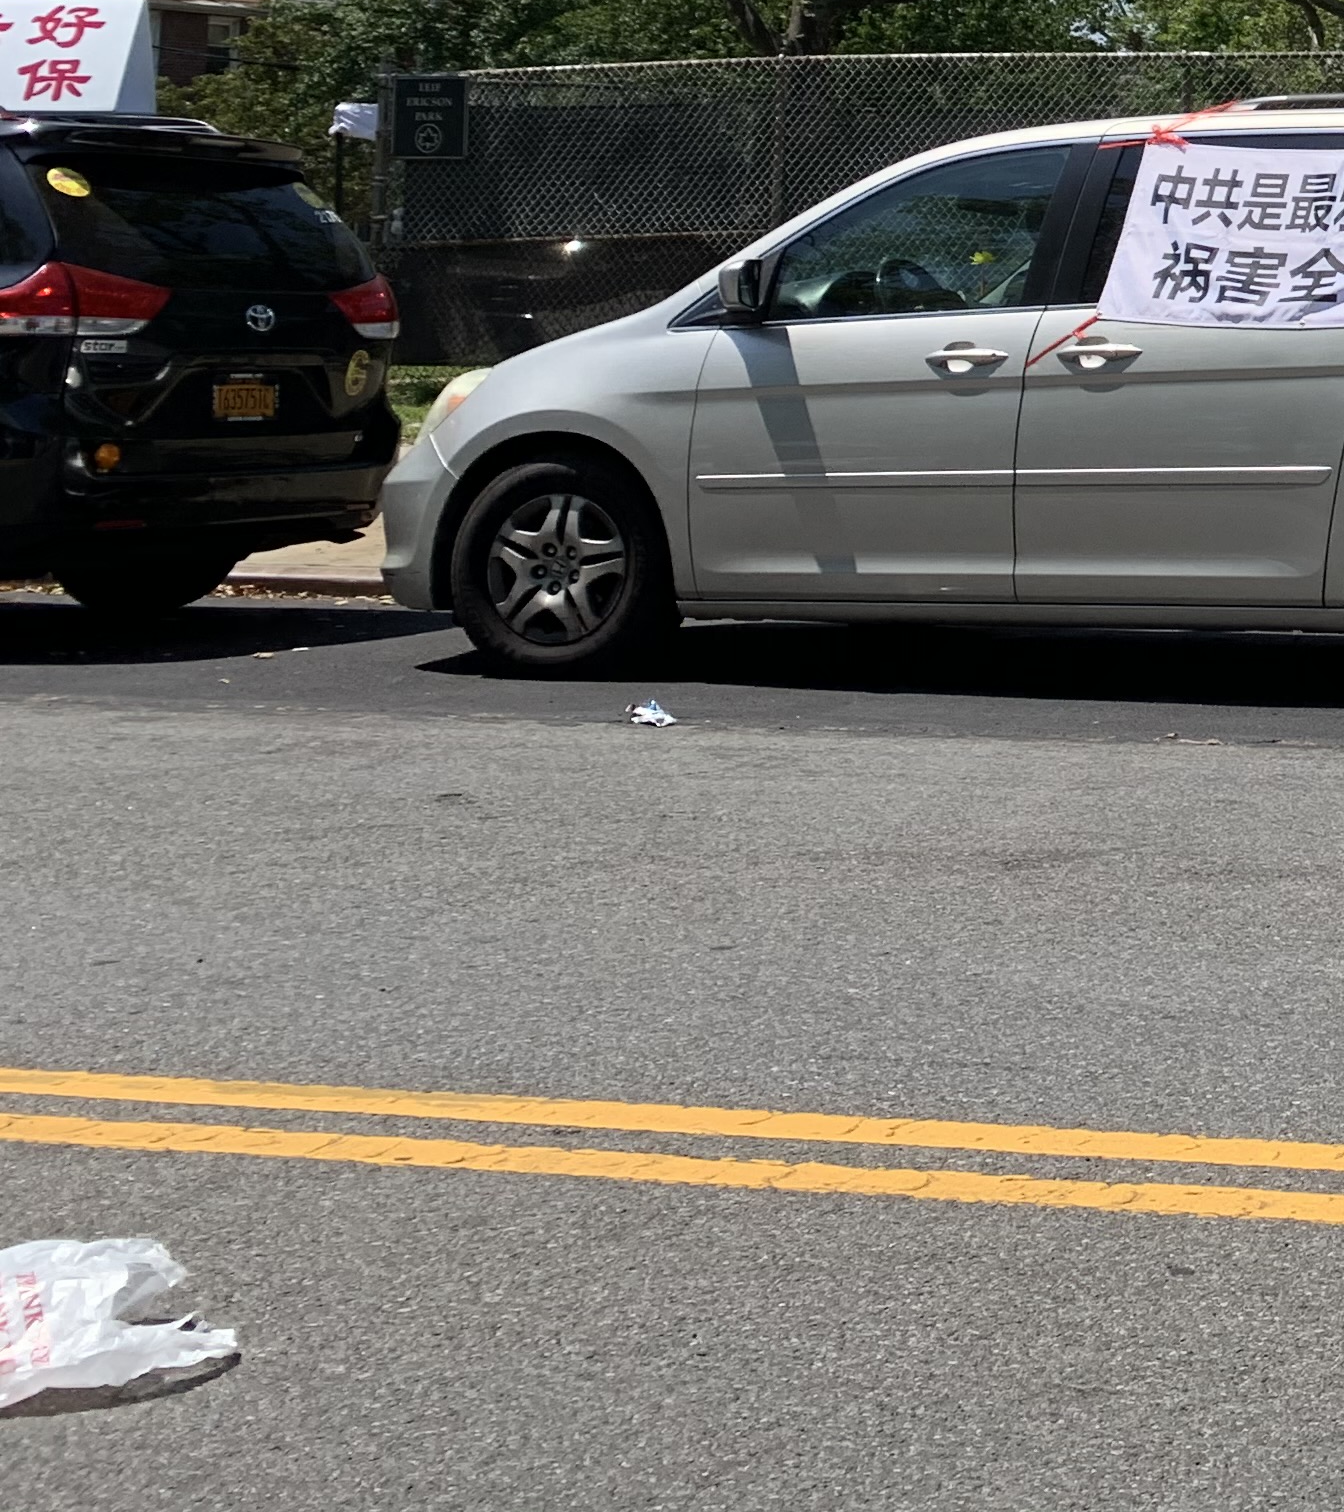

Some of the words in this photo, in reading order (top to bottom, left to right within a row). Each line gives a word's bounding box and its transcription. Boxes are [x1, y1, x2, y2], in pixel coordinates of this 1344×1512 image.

[0, 5, 106, 48] 好
[17, 59, 92, 101] 保
[406, 97, 453, 107] ERICSON
[415, 111, 443, 121] PARK
